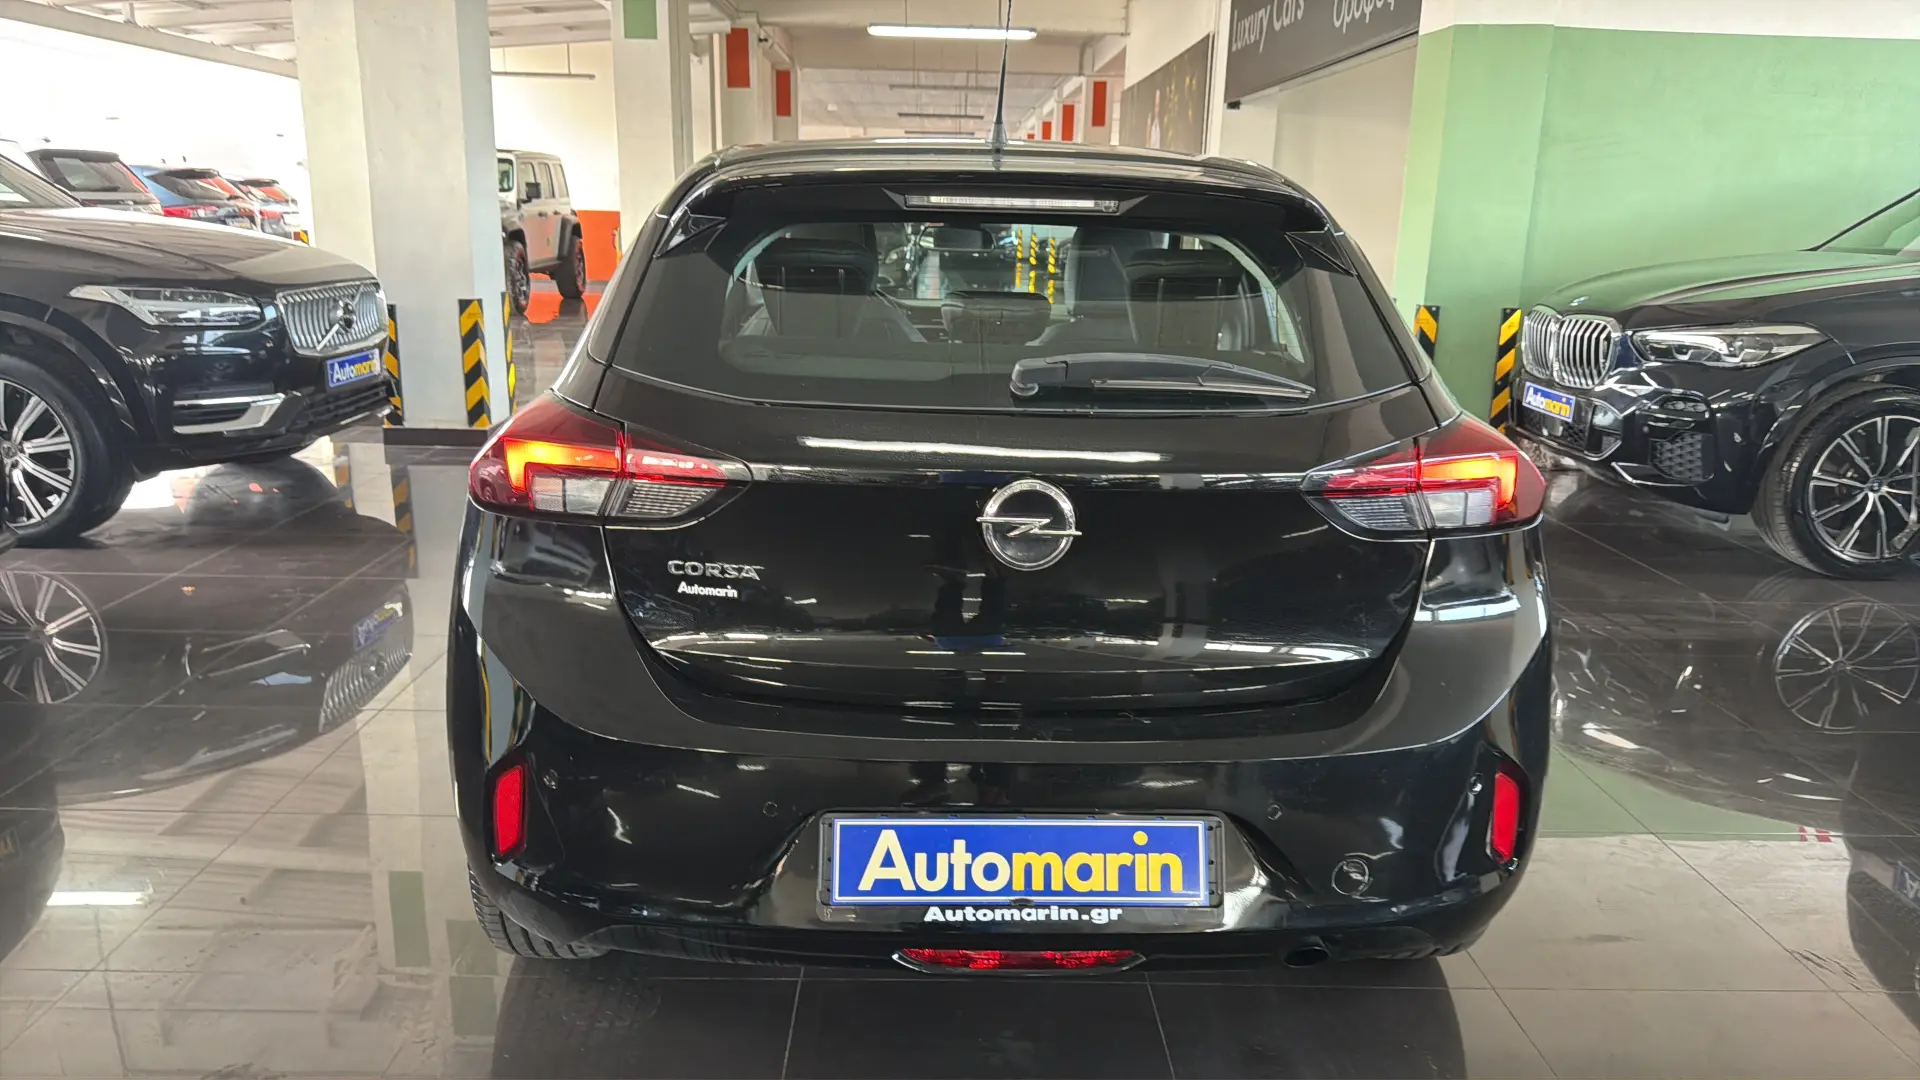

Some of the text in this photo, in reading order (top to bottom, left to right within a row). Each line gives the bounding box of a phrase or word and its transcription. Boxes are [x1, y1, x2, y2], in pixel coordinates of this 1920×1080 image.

[1232, 0, 1305, 53] Luxury Cars
[1526, 387, 1571, 417] Automarin
[667, 560, 765, 580] CORSA
[677, 581, 738, 598] Automarin
[858, 829, 1184, 892] Automarin
[923, 904, 1123, 924] Automarin.gr
